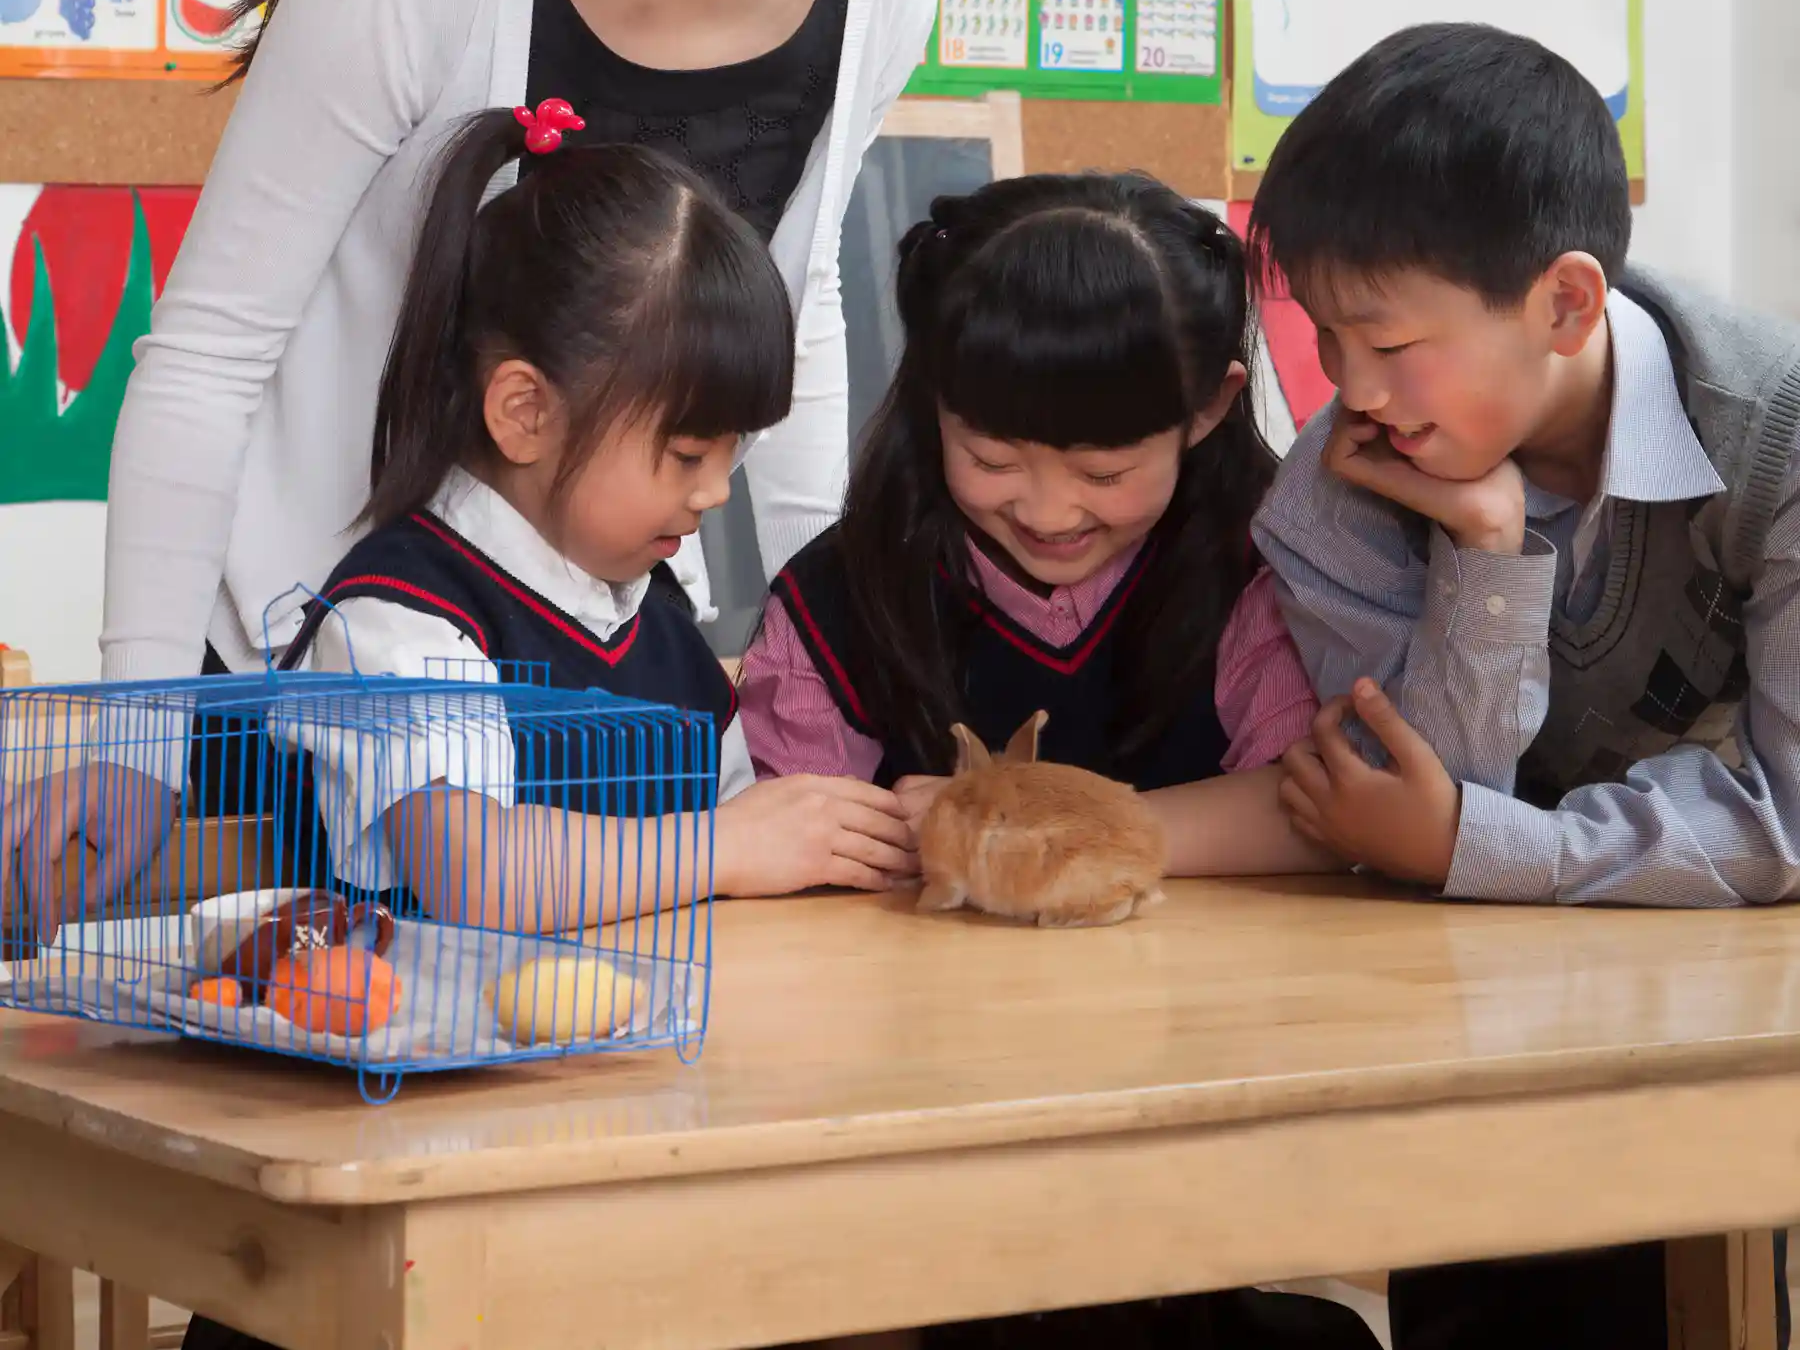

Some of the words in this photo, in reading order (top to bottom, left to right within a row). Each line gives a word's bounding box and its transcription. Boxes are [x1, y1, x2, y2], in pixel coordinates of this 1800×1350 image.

[944, 37, 965, 60] 18
[1043, 41, 1064, 64] 19
[1141, 46, 1166, 68] 20
